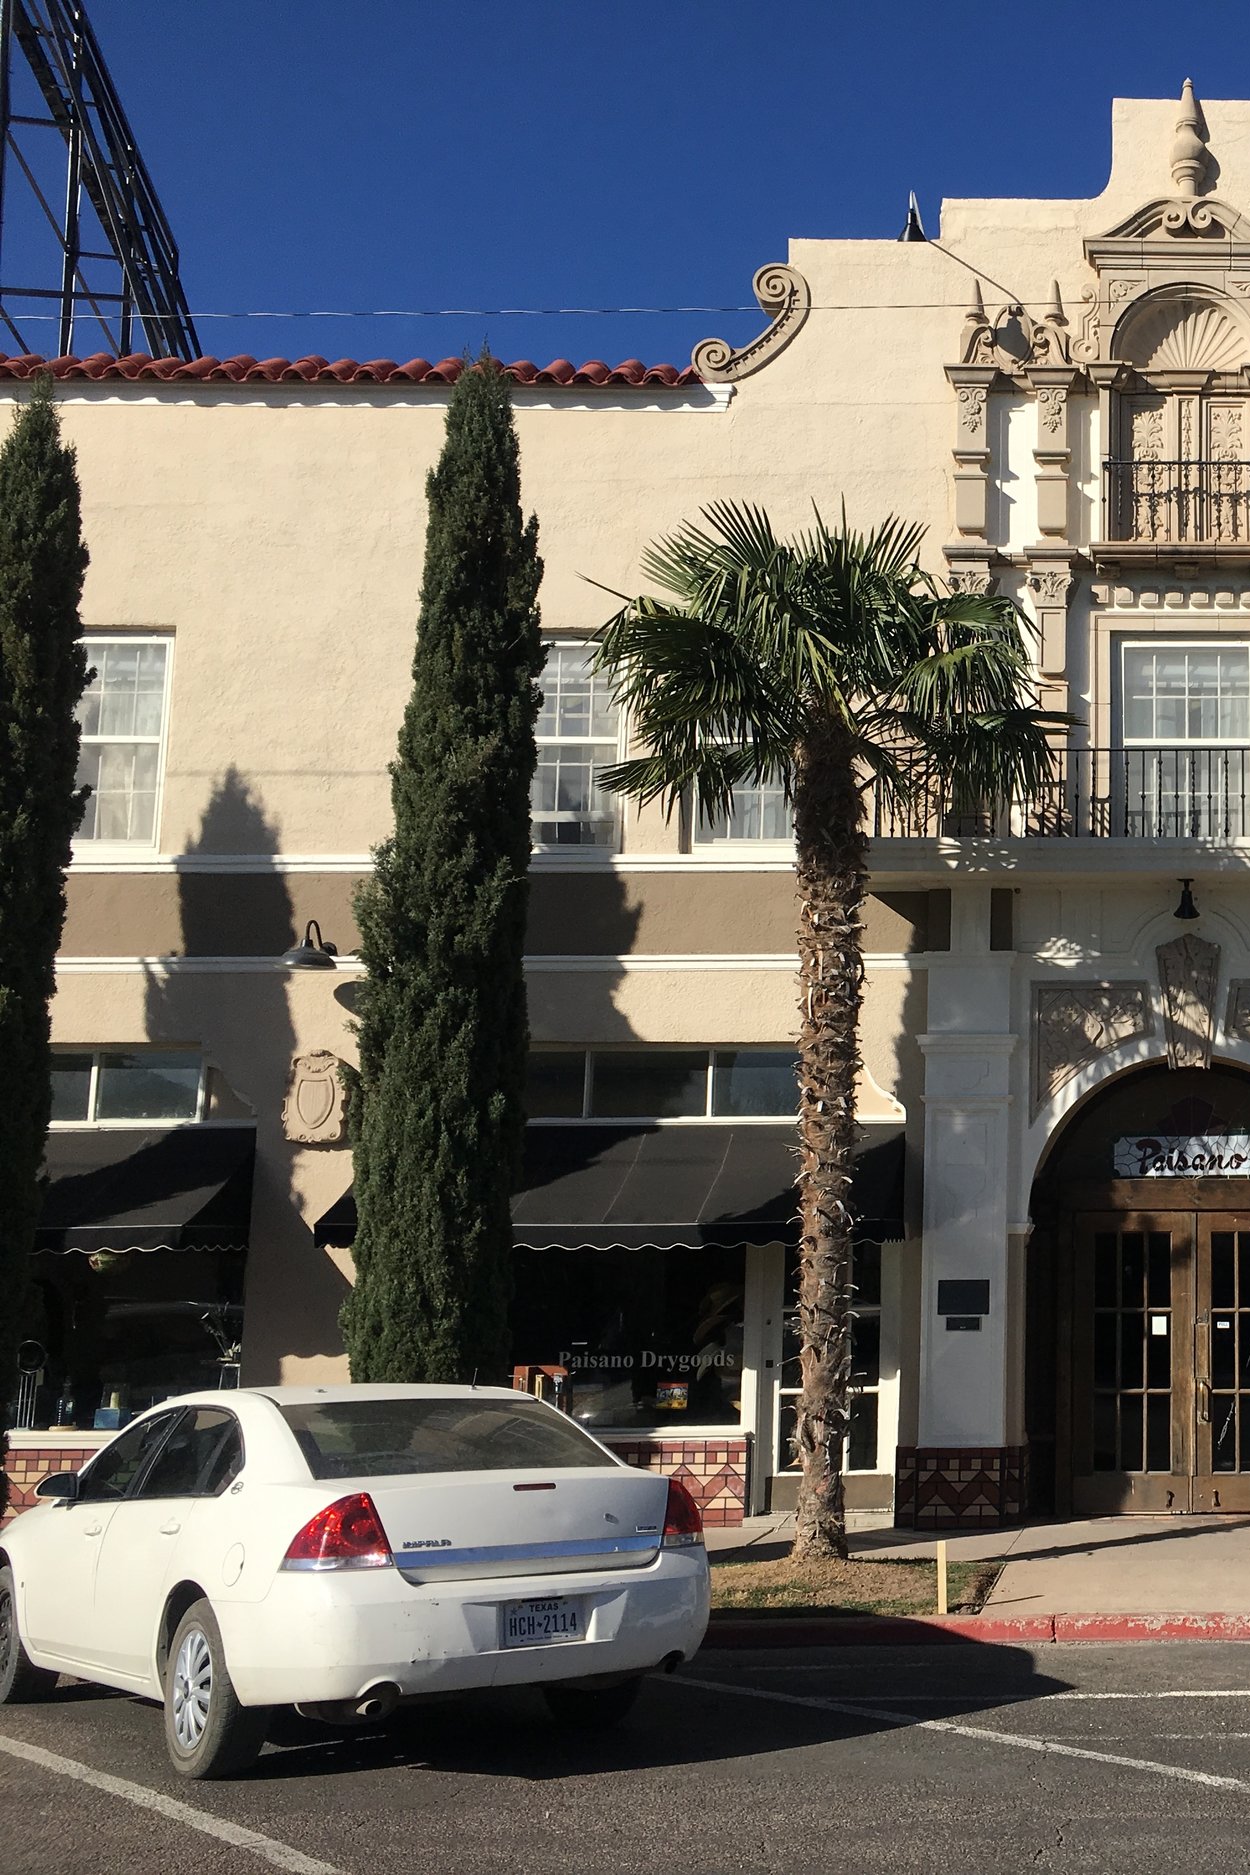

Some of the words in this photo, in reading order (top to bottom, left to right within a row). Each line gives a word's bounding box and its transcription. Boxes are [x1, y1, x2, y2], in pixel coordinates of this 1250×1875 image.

[1136, 1138, 1248, 1175] Paisano
[559, 1351, 634, 1368] Paisano
[640, 1351, 735, 1372] Drygoods
[529, 1602, 560, 1613] TEXAS
